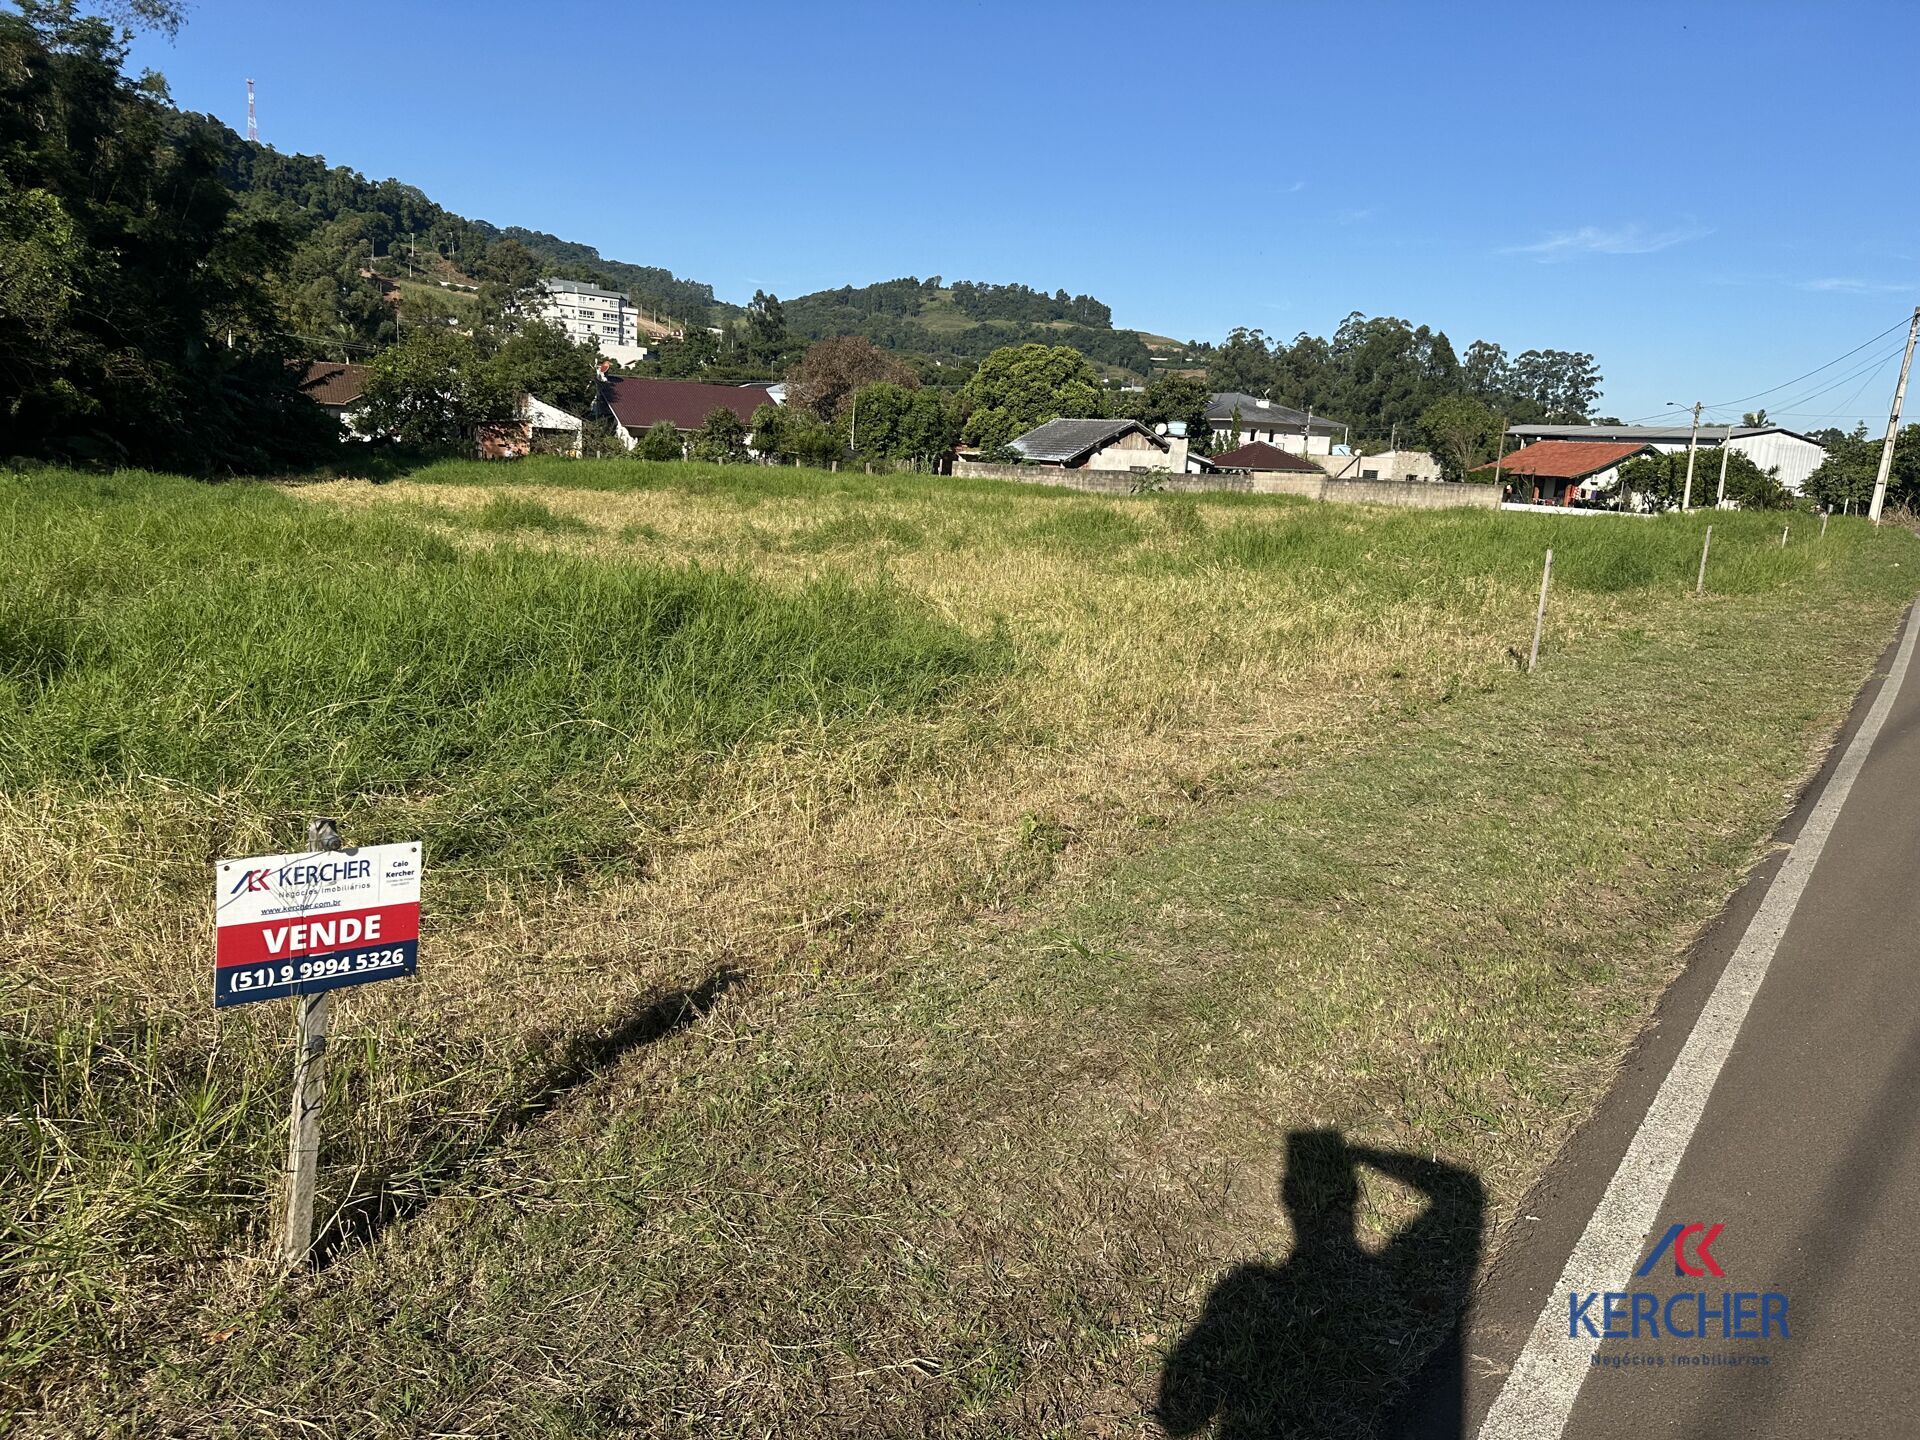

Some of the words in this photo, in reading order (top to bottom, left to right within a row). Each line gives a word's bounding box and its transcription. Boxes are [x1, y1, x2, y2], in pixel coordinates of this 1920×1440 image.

[392, 860, 409, 868] Caio
[279, 860, 371, 887] KERCHER
[385, 870, 415, 878] Kercher
[321, 882, 371, 894] Imobiliários
[260, 900, 341, 915] www.kercher.com.br
[262, 914, 382, 954] VENDE
[229, 967, 275, 992] (51)
[280, 965, 294, 982] 9
[300, 956, 351, 979] 9994
[355, 948, 404, 970] 5326
